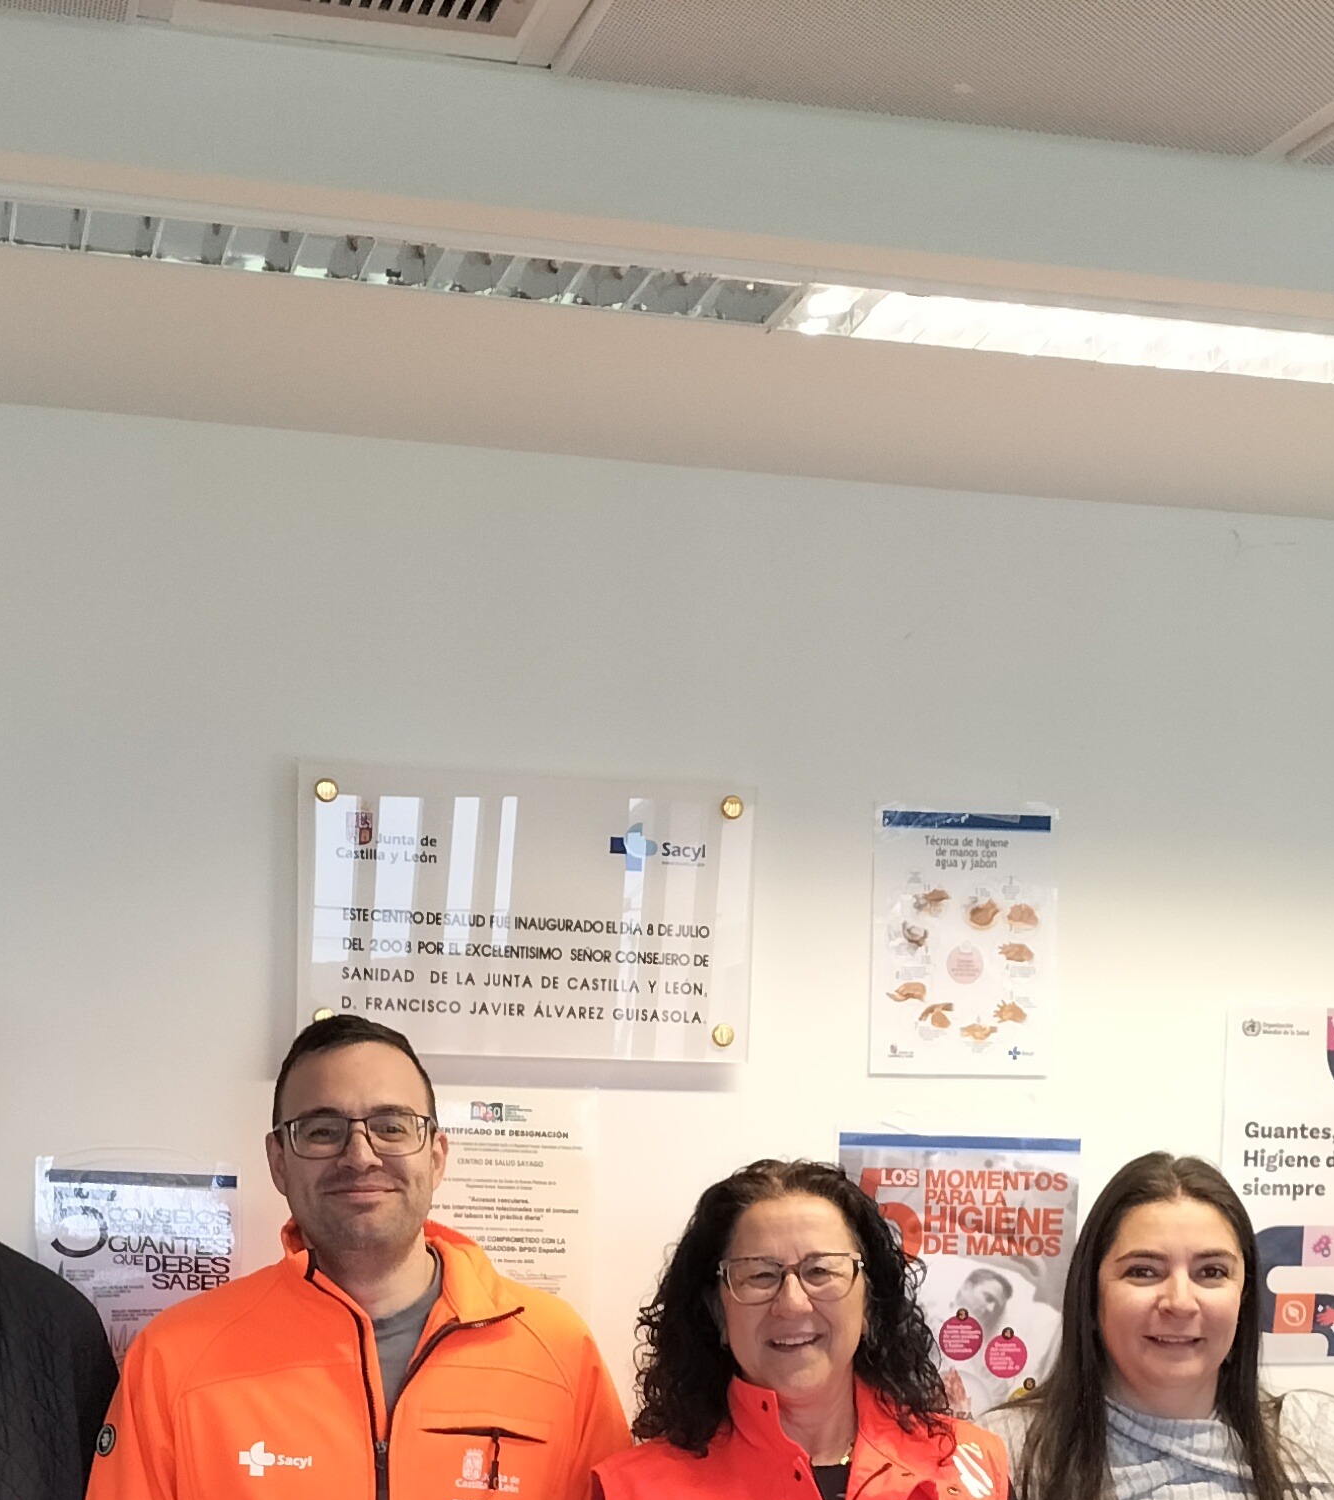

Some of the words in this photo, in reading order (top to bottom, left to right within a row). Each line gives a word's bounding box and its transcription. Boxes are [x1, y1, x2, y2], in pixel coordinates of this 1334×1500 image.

[375, 834, 414, 847] Junta
[421, 836, 436, 847] de
[925, 835, 958, 846] Técnica
[976, 838, 1008, 849] higiene
[336, 847, 385, 860] Castilla
[404, 851, 437, 863] León
[662, 842, 705, 861] Sacyl
[950, 849, 978, 857] manos
[981, 850, 997, 858] con
[936, 859, 957, 869] agua
[970, 856, 997, 870] jabón
[343, 908, 368, 922] ESTE
[370, 909, 423, 924] CENTRO
[427, 912, 441, 925] DE
[444, 913, 485, 927] SALUD
[515, 917, 603, 933] INAUGURADO
[676, 925, 710, 938] JULIO
[343, 938, 364, 951] DEL
[370, 939, 411, 954] 2008
[418, 941, 444, 955] POR
[466, 944, 562, 960] EXCELENTISIMO
[571, 946, 611, 962] SEÑOR
[615, 951, 689, 966] CONSEJERO
[342, 967, 414, 982] SANIDAD
[430, 971, 447, 984] DE
[457, 972, 475, 985] LA
[484, 973, 532, 988] JUNTA
[542, 976, 558, 989] DE
[567, 977, 639, 993] CASTILLA
[648, 981, 656, 993] Y
[366, 997, 460, 1013] FRANCISCO
[470, 1002, 524, 1016] JAVIER
[534, 1001, 603, 1019] ÁLVAREZ
[613, 1008, 707, 1023] GUISASOLA.
[509, 1130, 568, 1138] DESIGNACIÓN
[1244, 1149, 1320, 1172] Higiene
[881, 1169, 918, 1186] LOS
[926, 1170, 1068, 1192] MOMENTOS
[1243, 1177, 1325, 1200] siempre
[925, 1189, 976, 1205] PARA
[982, 1190, 1007, 1206] LA
[924, 1206, 1064, 1235] HIGIENE
[109, 1236, 232, 1255] GUANTES
[923, 1235, 958, 1255] DE
[966, 1235, 1061, 1257] MANOS
[113, 1255, 143, 1265] QUE
[146, 1255, 230, 1274] DEBES
[277, 1454, 312, 1469] Sacyl
